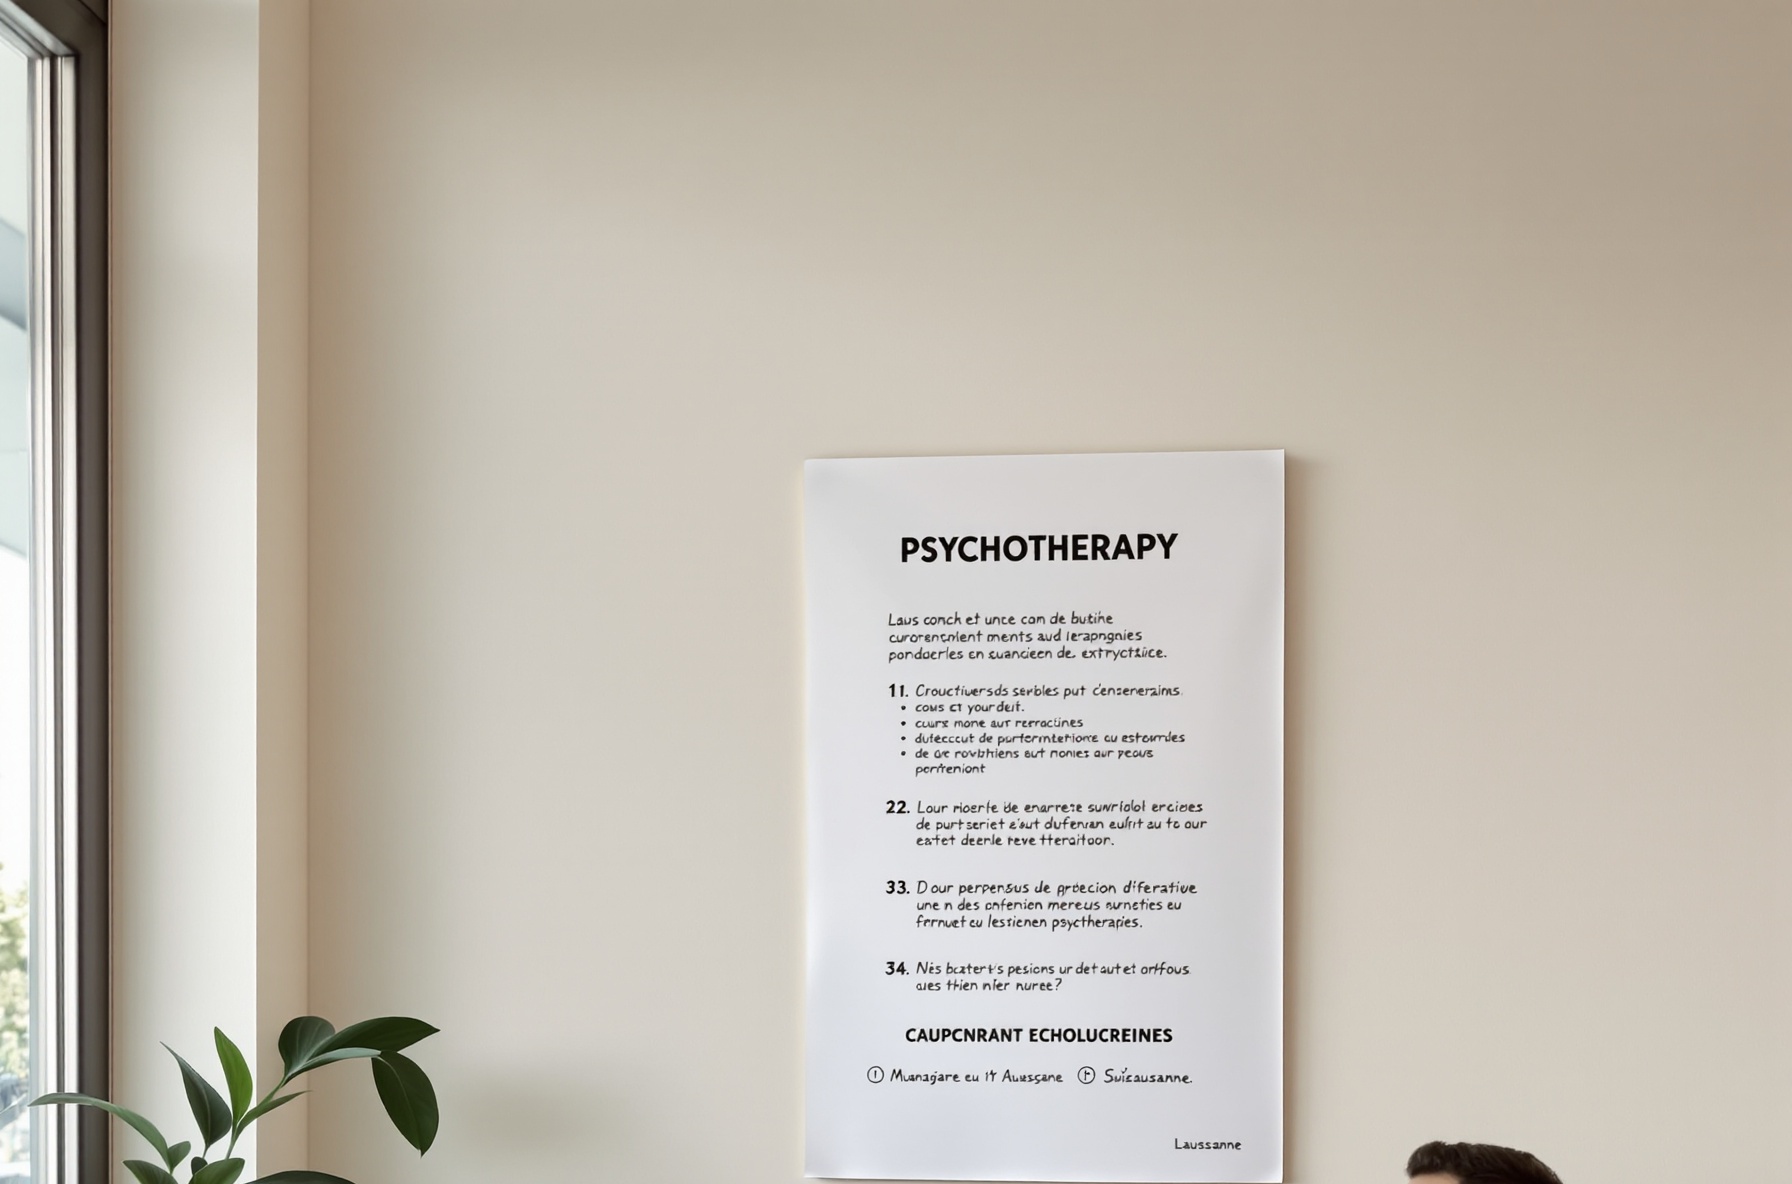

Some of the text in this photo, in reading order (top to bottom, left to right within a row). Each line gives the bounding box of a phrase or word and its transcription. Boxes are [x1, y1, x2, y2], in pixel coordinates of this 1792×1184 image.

[901, 533, 1178, 563] PSYCHOTHERAPY
[1050, 612, 1066, 624] de
[889, 683, 908, 697] 11.
[1063, 685, 1087, 700] put
[968, 704, 995, 715] your
[979, 733, 993, 743] de
[915, 748, 929, 758] de
[886, 800, 910, 814] 22.
[917, 801, 948, 814] Lour
[916, 817, 930, 831] de
[1184, 821, 1207, 829] our
[886, 880, 910, 894] 33.
[957, 897, 980, 911] des
[885, 961, 909, 975] 34.
[1029, 1028, 1173, 1043] ECHOLUCREINES
[1175, 1138, 1241, 1150] Laussanne
